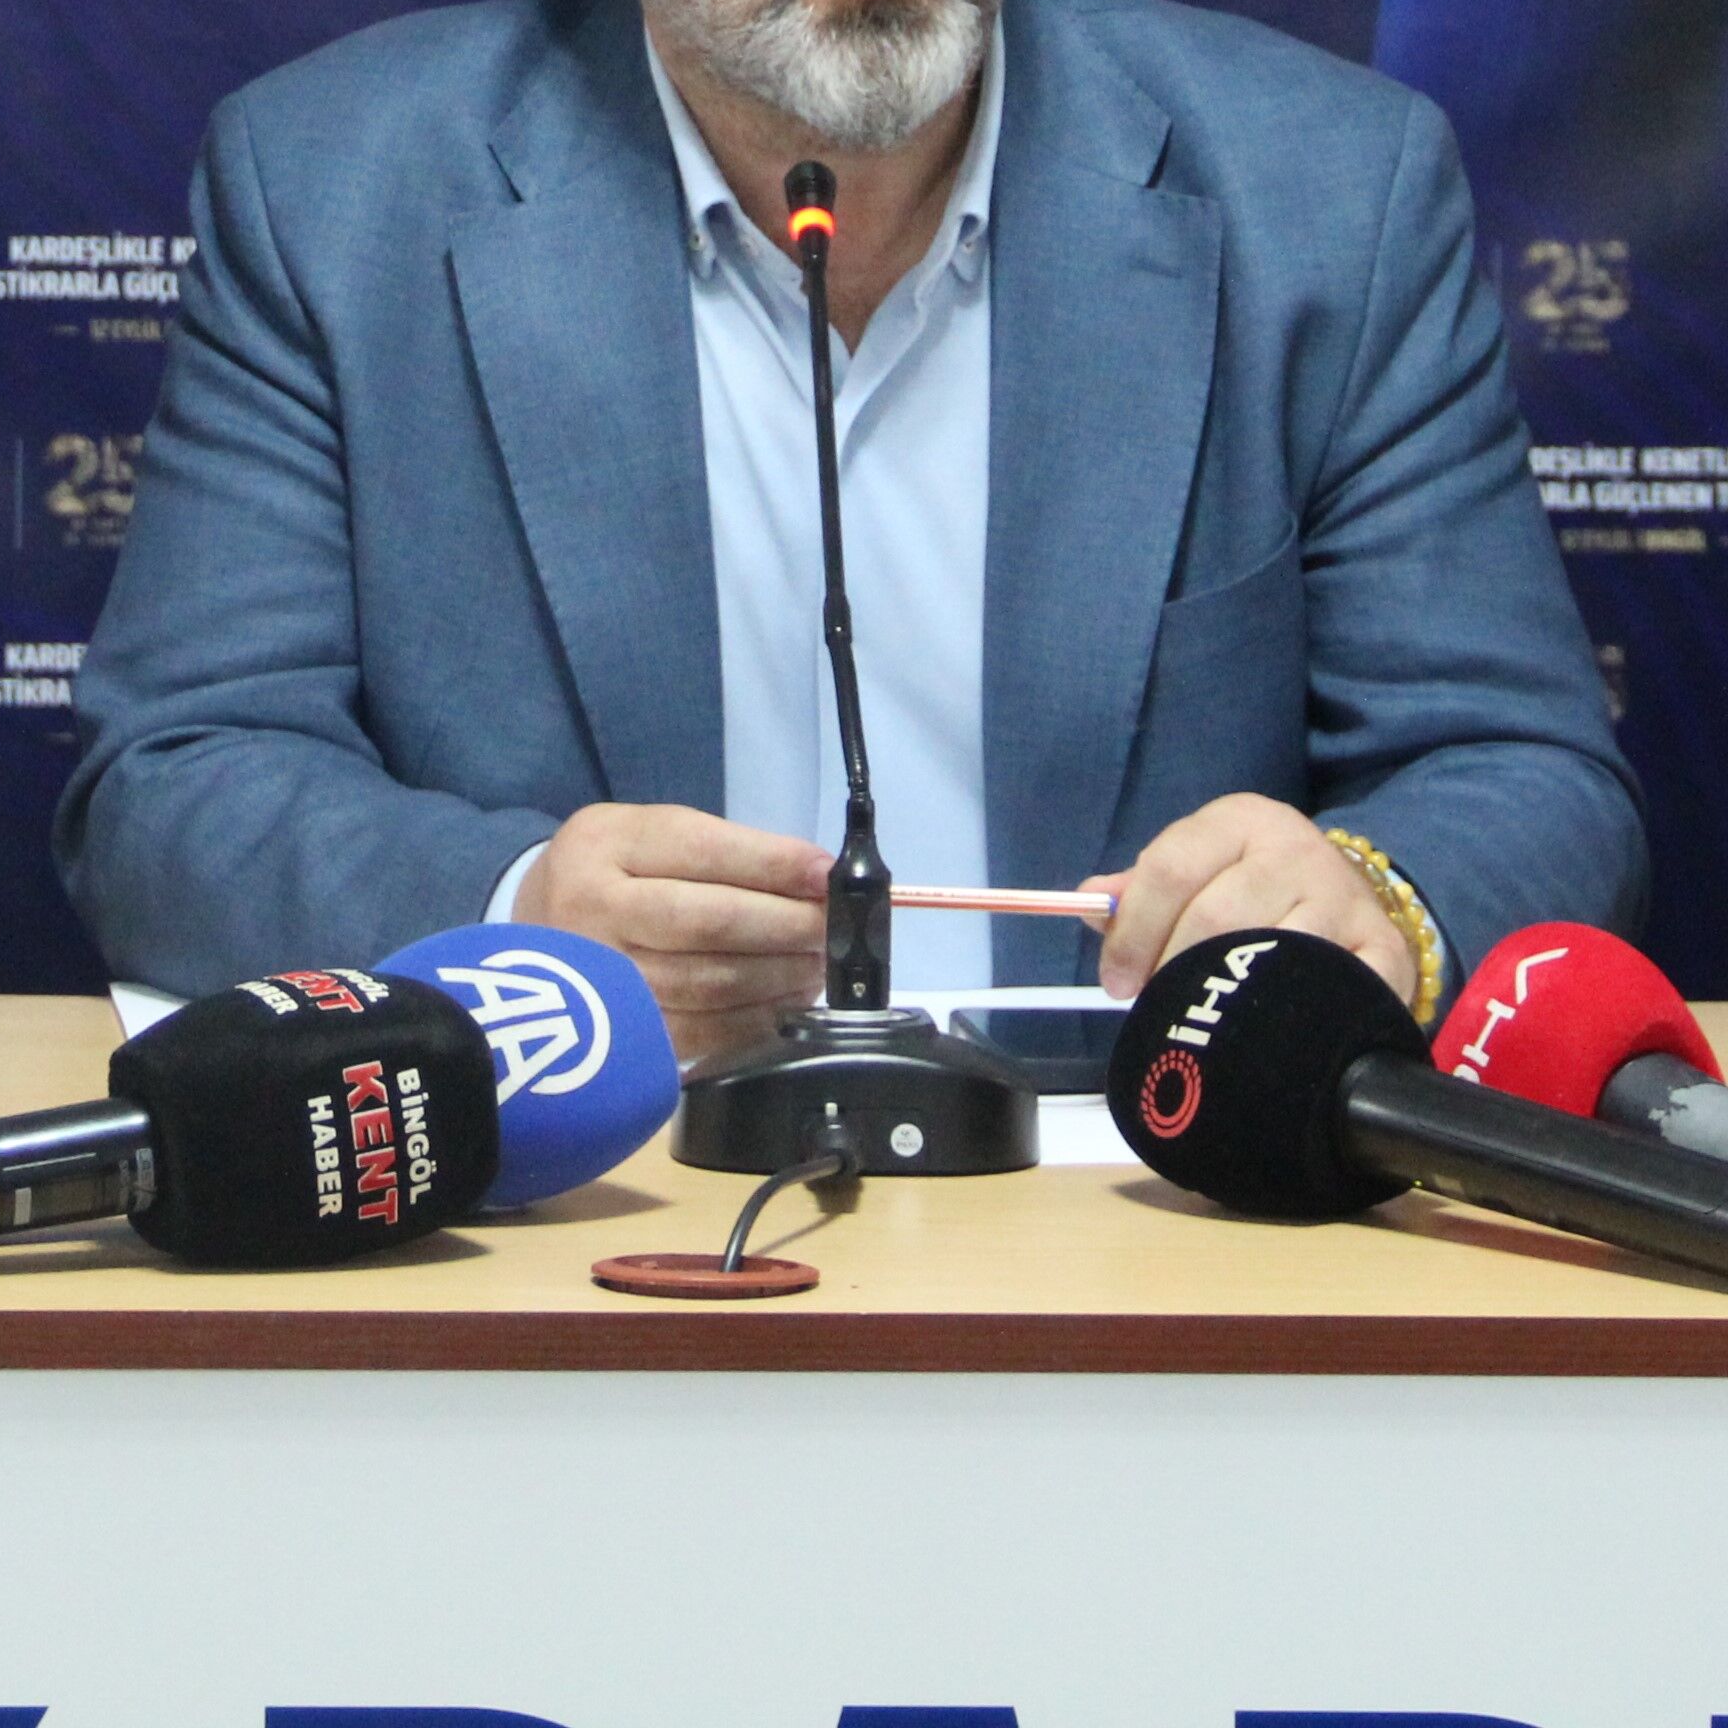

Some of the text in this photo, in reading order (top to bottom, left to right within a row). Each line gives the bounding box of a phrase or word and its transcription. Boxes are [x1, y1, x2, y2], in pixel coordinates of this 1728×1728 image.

[436, 966, 581, 1106] AA
[1166, 939, 1279, 1047] İHA
[306, 1094, 344, 1219] HABER
[342, 1060, 400, 1225] KENT
[396, 1067, 438, 1206] BİNGÖL
